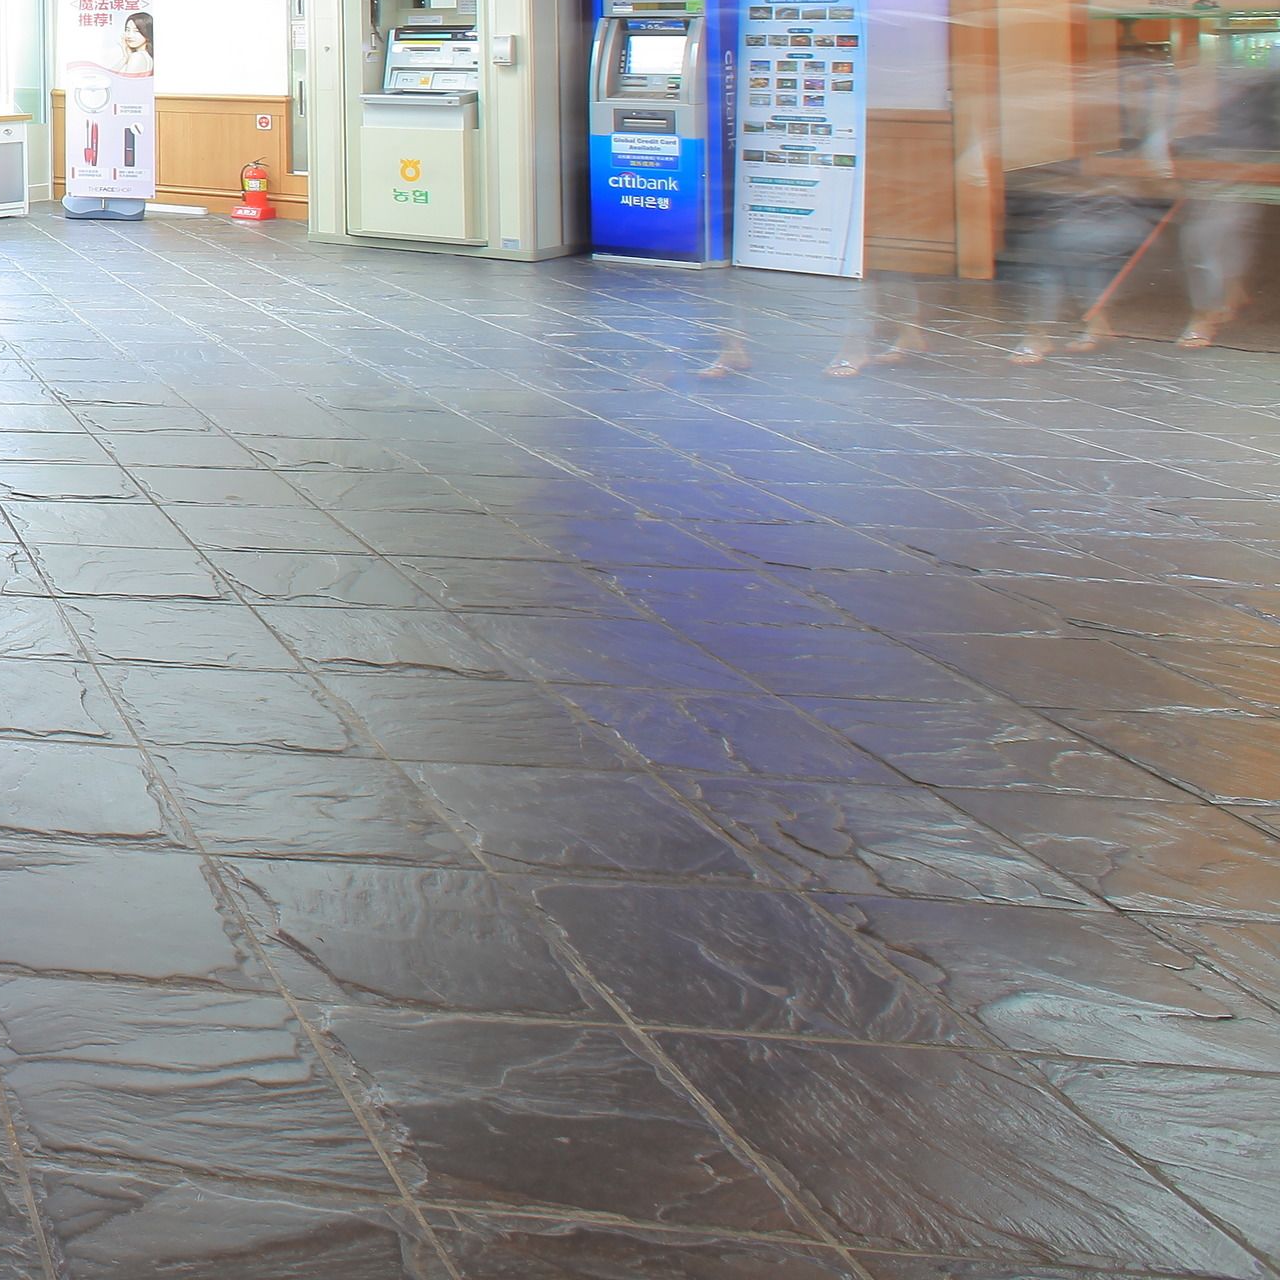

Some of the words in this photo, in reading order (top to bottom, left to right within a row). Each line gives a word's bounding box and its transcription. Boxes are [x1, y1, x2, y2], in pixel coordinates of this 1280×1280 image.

[608, 174, 679, 191] citibank
[392, 188, 428, 204] 농협
[620, 195, 670, 210] 씨티은행
